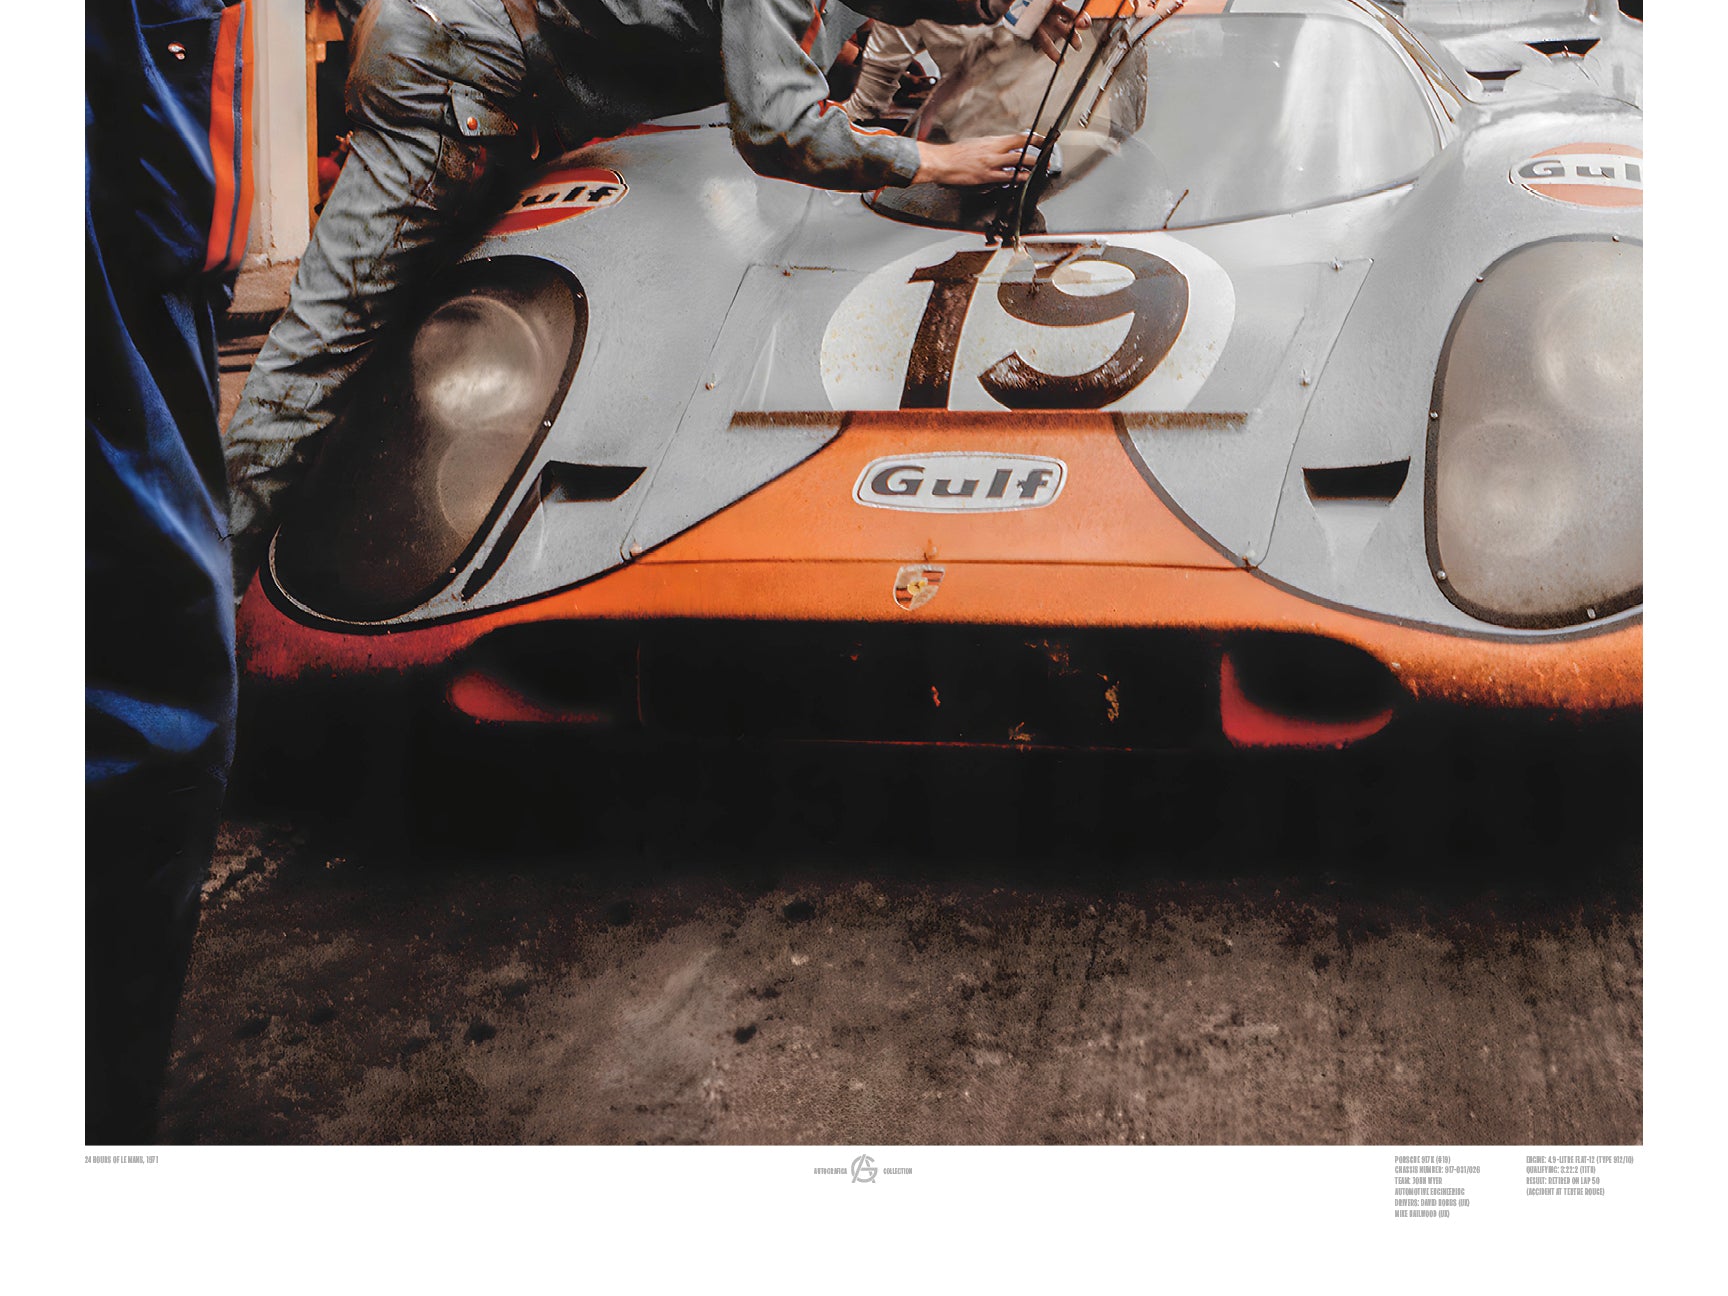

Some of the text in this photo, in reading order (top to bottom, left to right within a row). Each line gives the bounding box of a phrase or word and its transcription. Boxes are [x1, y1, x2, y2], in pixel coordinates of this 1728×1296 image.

[1518, 159, 1642, 183] Gul
[521, 186, 619, 207] ulf
[898, 243, 1190, 412] 19
[871, 465, 1053, 499] Gulf
